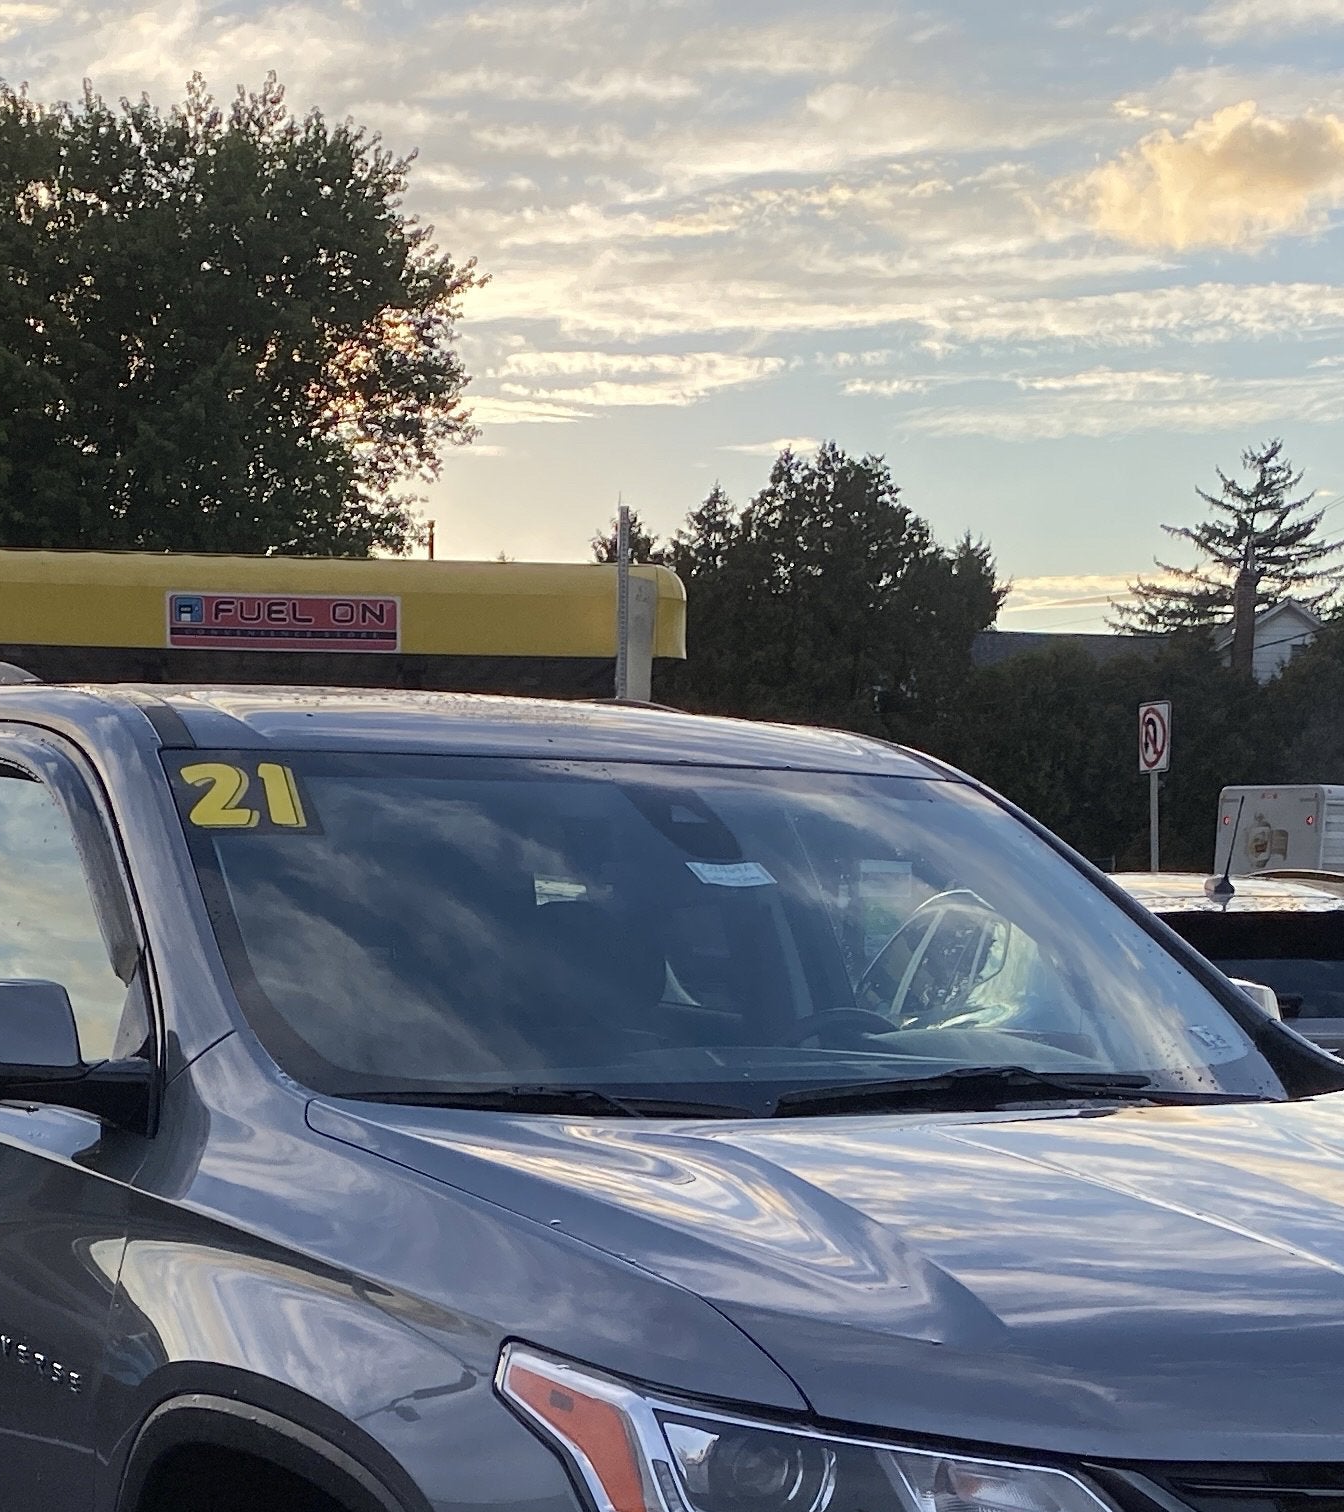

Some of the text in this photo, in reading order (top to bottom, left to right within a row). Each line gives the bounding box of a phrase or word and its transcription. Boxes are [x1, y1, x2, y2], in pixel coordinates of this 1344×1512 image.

[212, 600, 388, 626] FUEL ON
[179, 762, 307, 828] 21
